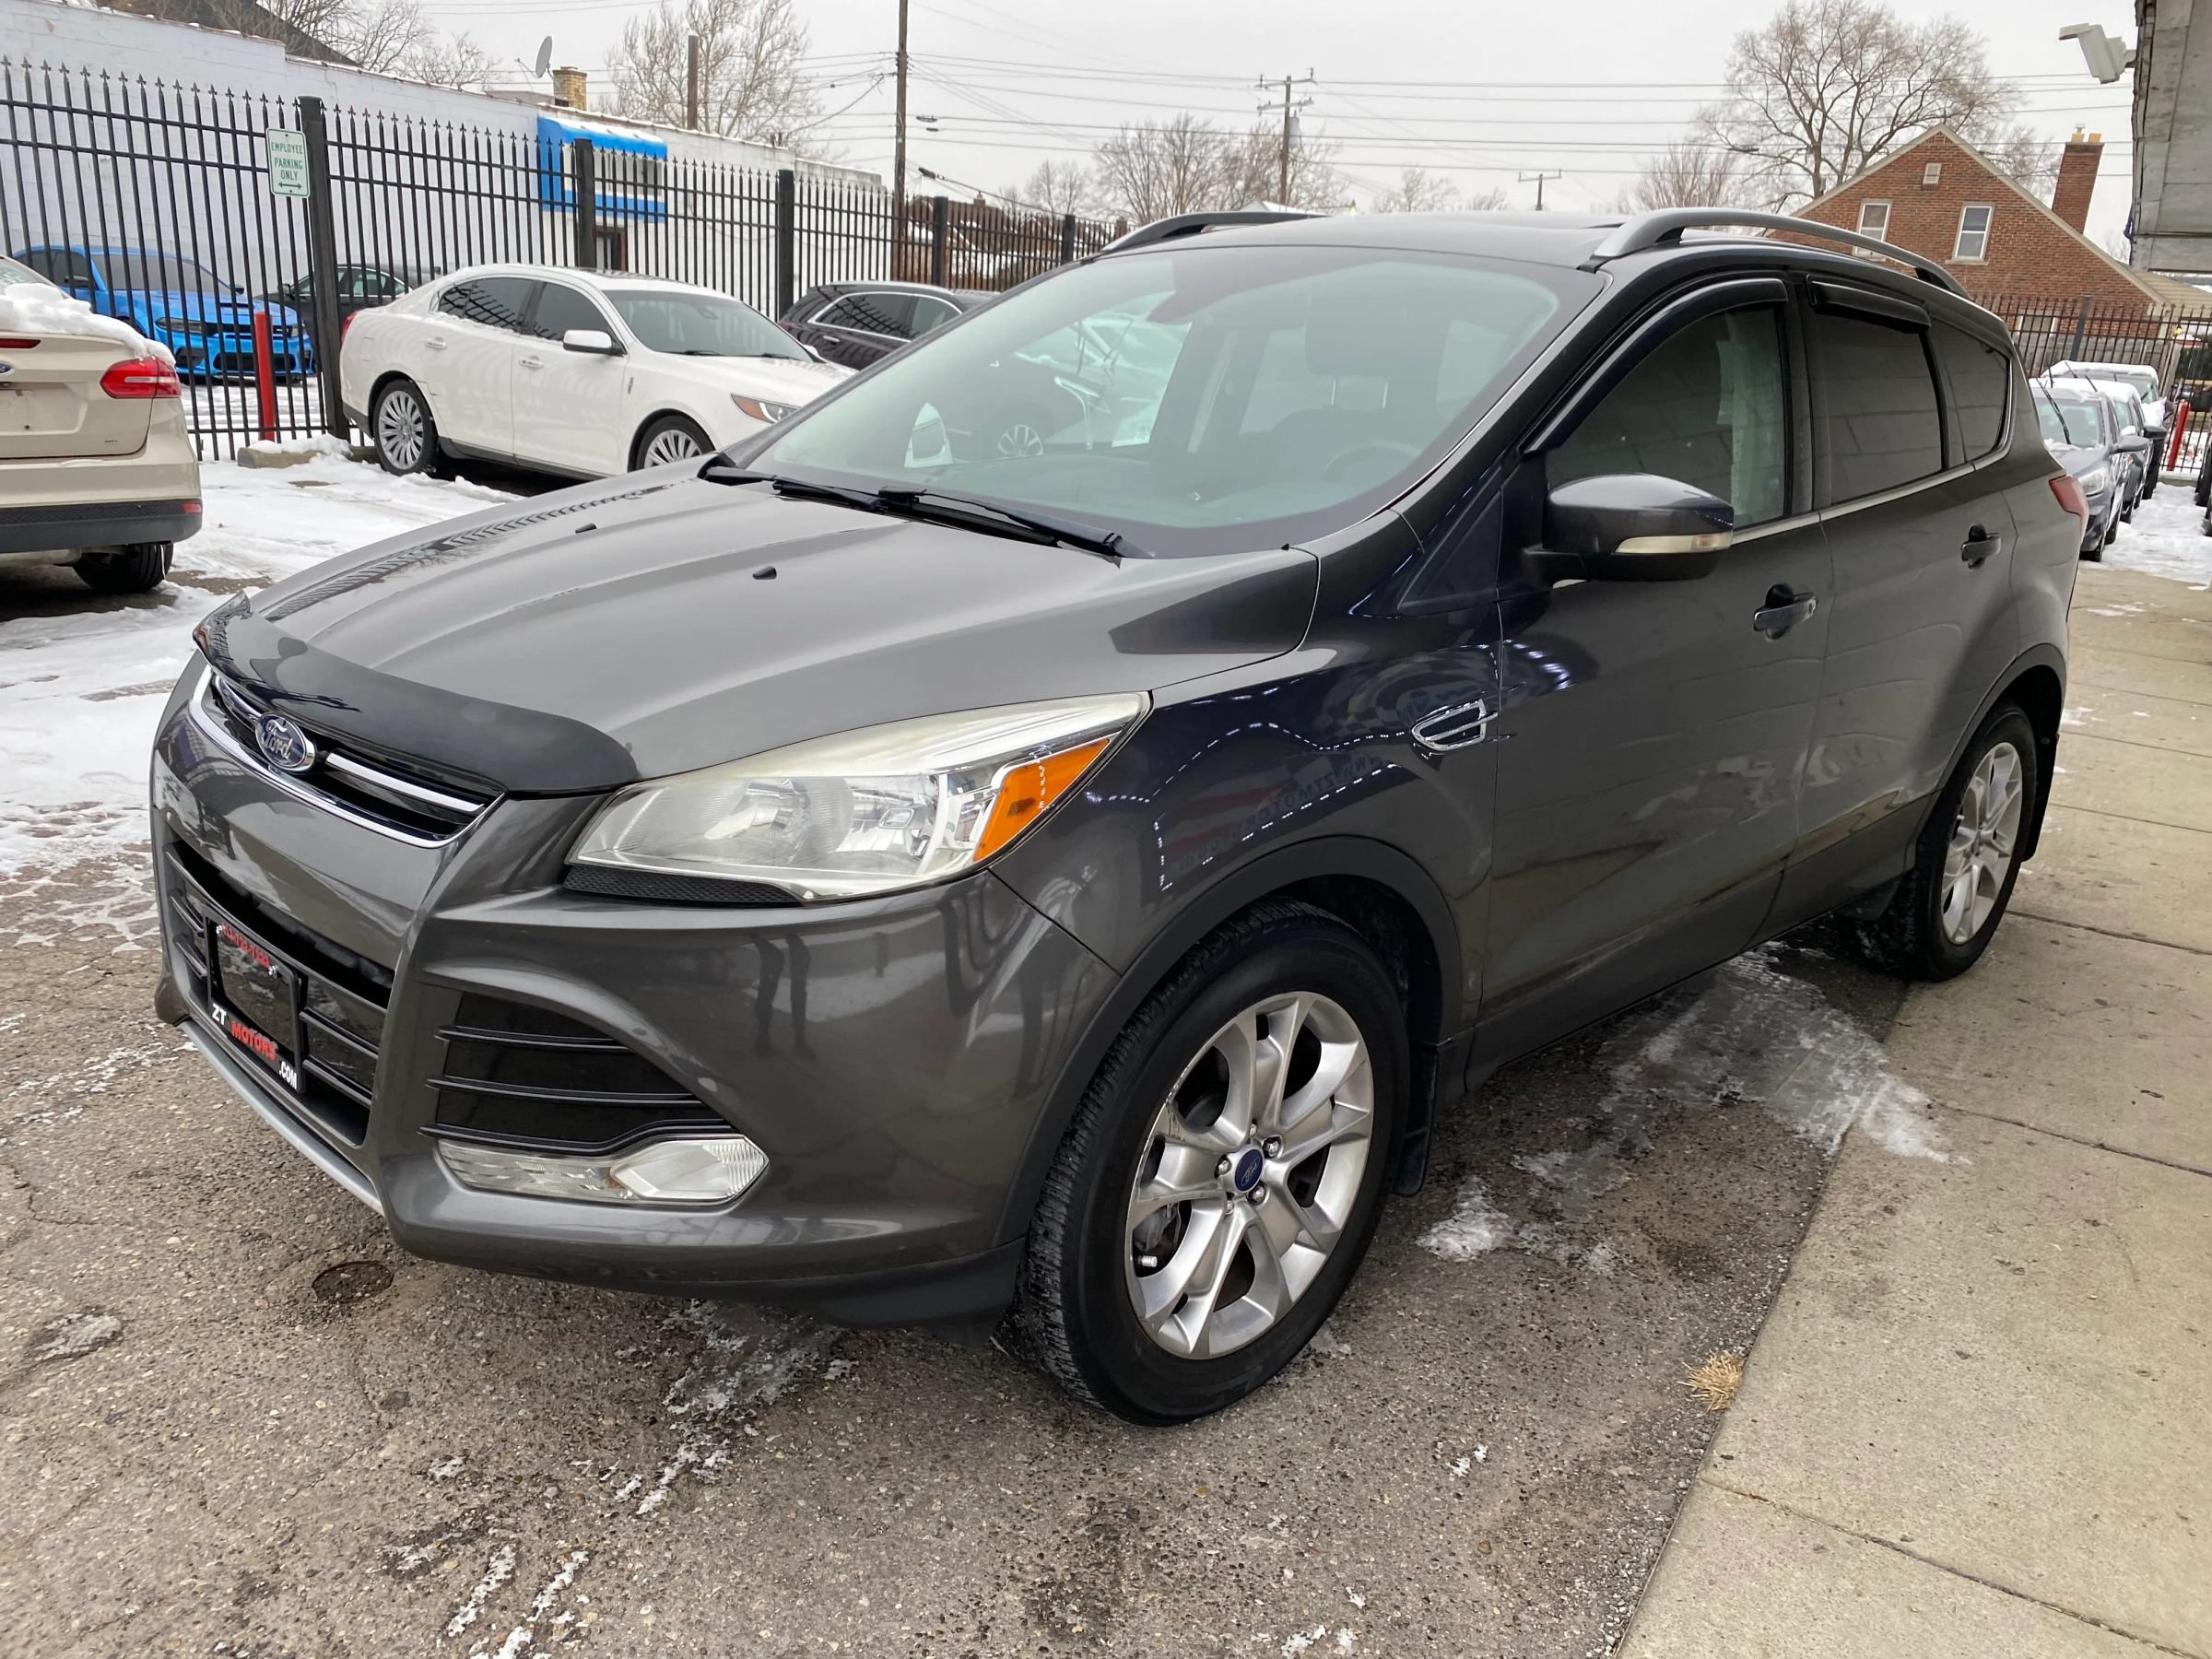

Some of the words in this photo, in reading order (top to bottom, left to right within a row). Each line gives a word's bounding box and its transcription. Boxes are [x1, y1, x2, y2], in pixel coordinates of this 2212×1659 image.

[271, 142, 303, 154] EMPLOYEE
[274, 157, 303, 170] PARKING
[280, 170, 298, 180] ONLY
[262, 719, 293, 759] Ford
[211, 1003, 228, 1025] ZT
[231, 1020, 276, 1060] MOTORS
[278, 1061, 298, 1089] .COM
[1241, 1156, 1260, 1187] Ford
